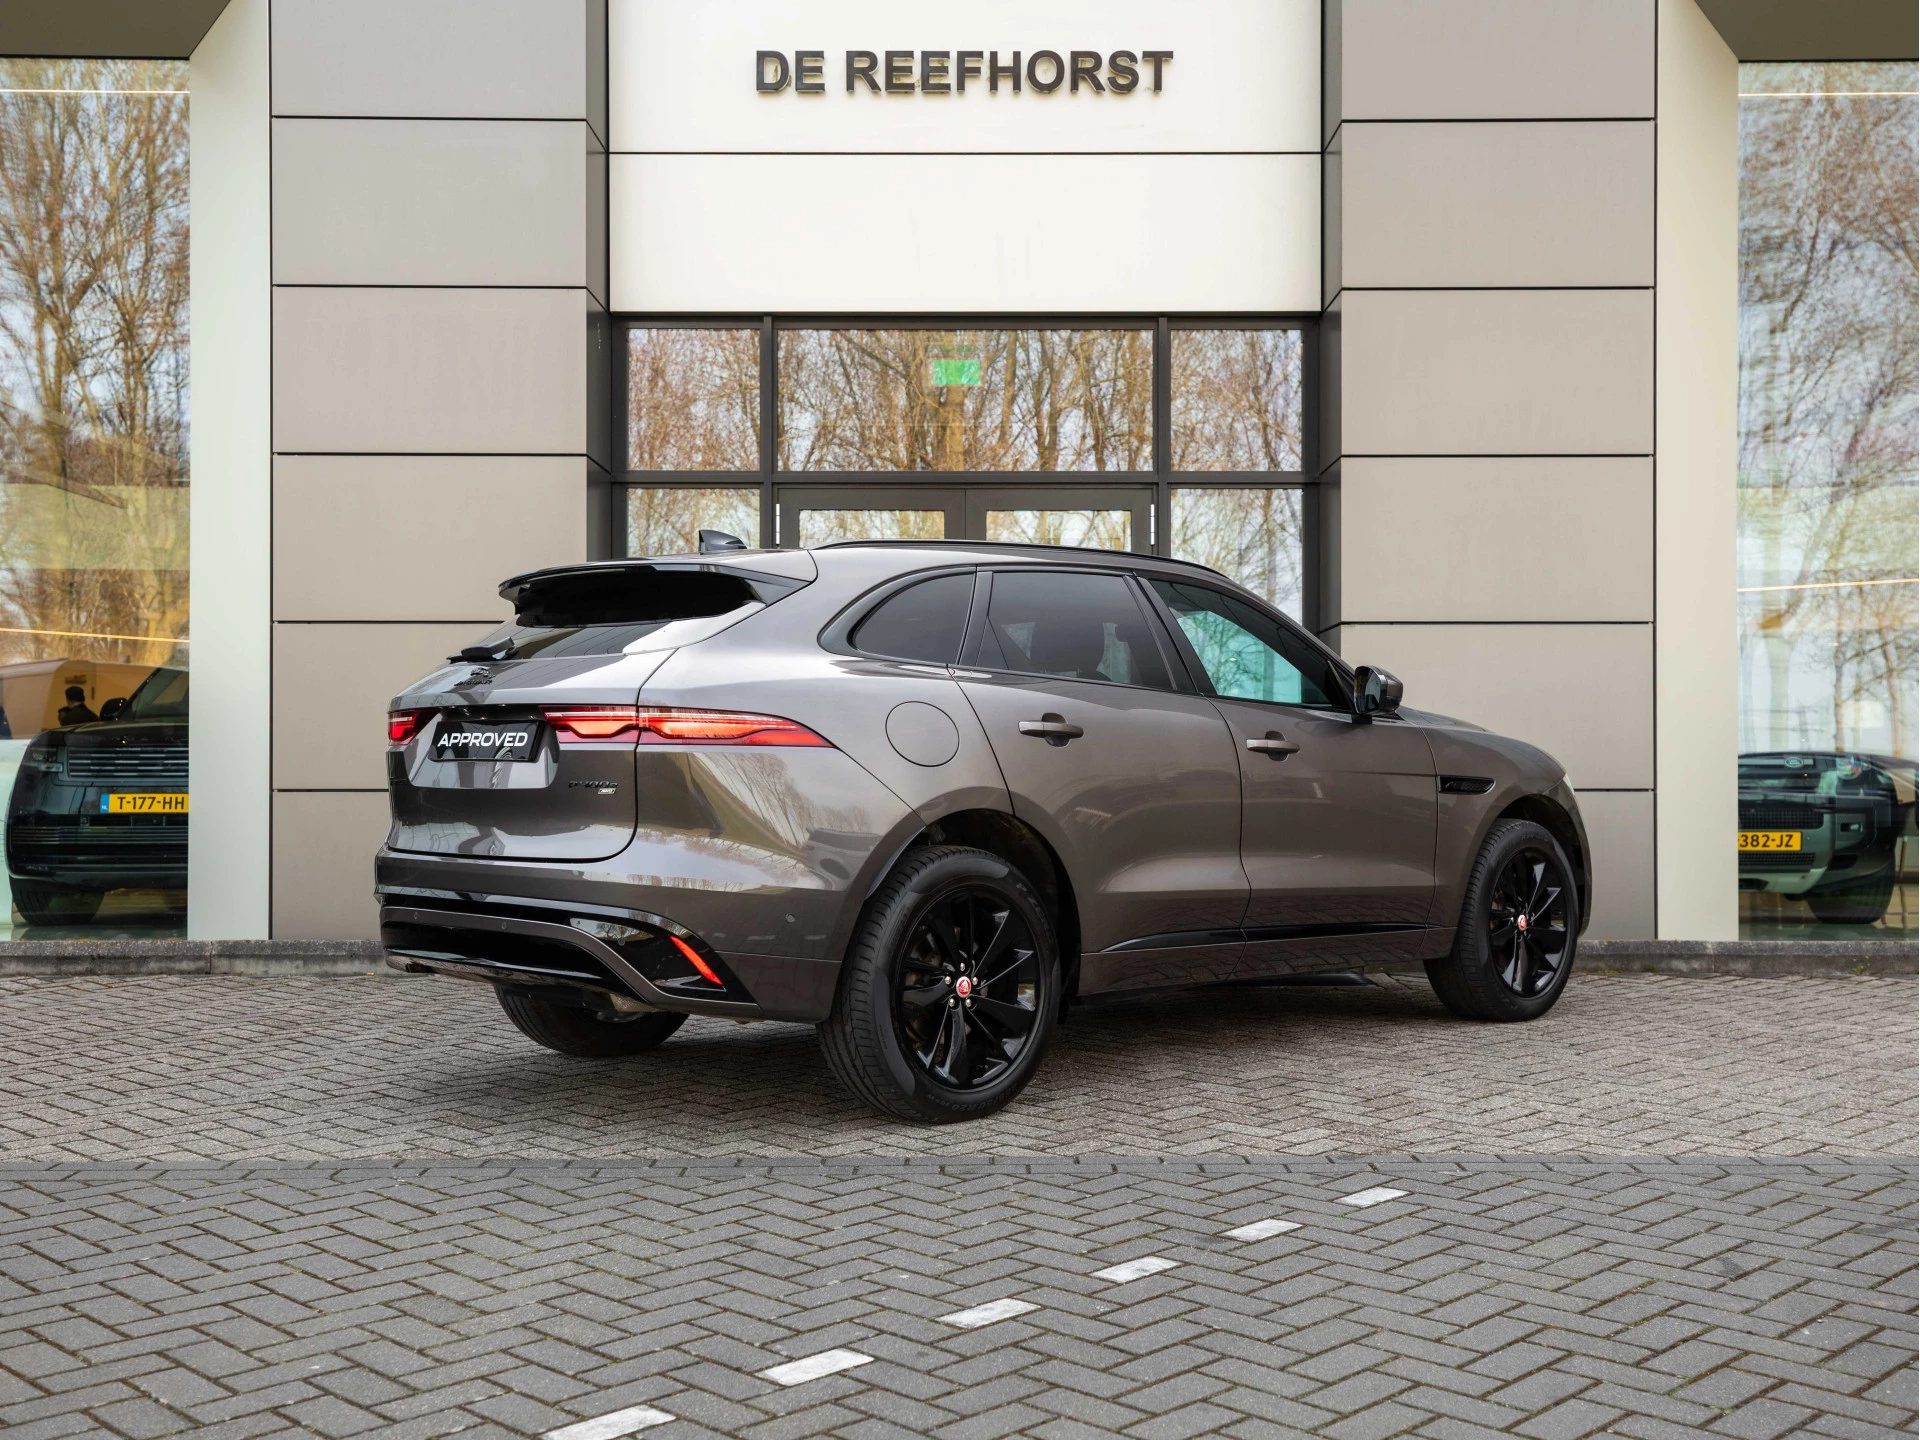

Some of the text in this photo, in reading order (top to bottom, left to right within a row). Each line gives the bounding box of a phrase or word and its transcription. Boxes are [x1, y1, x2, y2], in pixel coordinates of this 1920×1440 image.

[756, 49, 1174, 93] DE REEFHORST
[437, 732, 528, 747] APPROVED
[117, 796, 185, 810] T-177-HH
